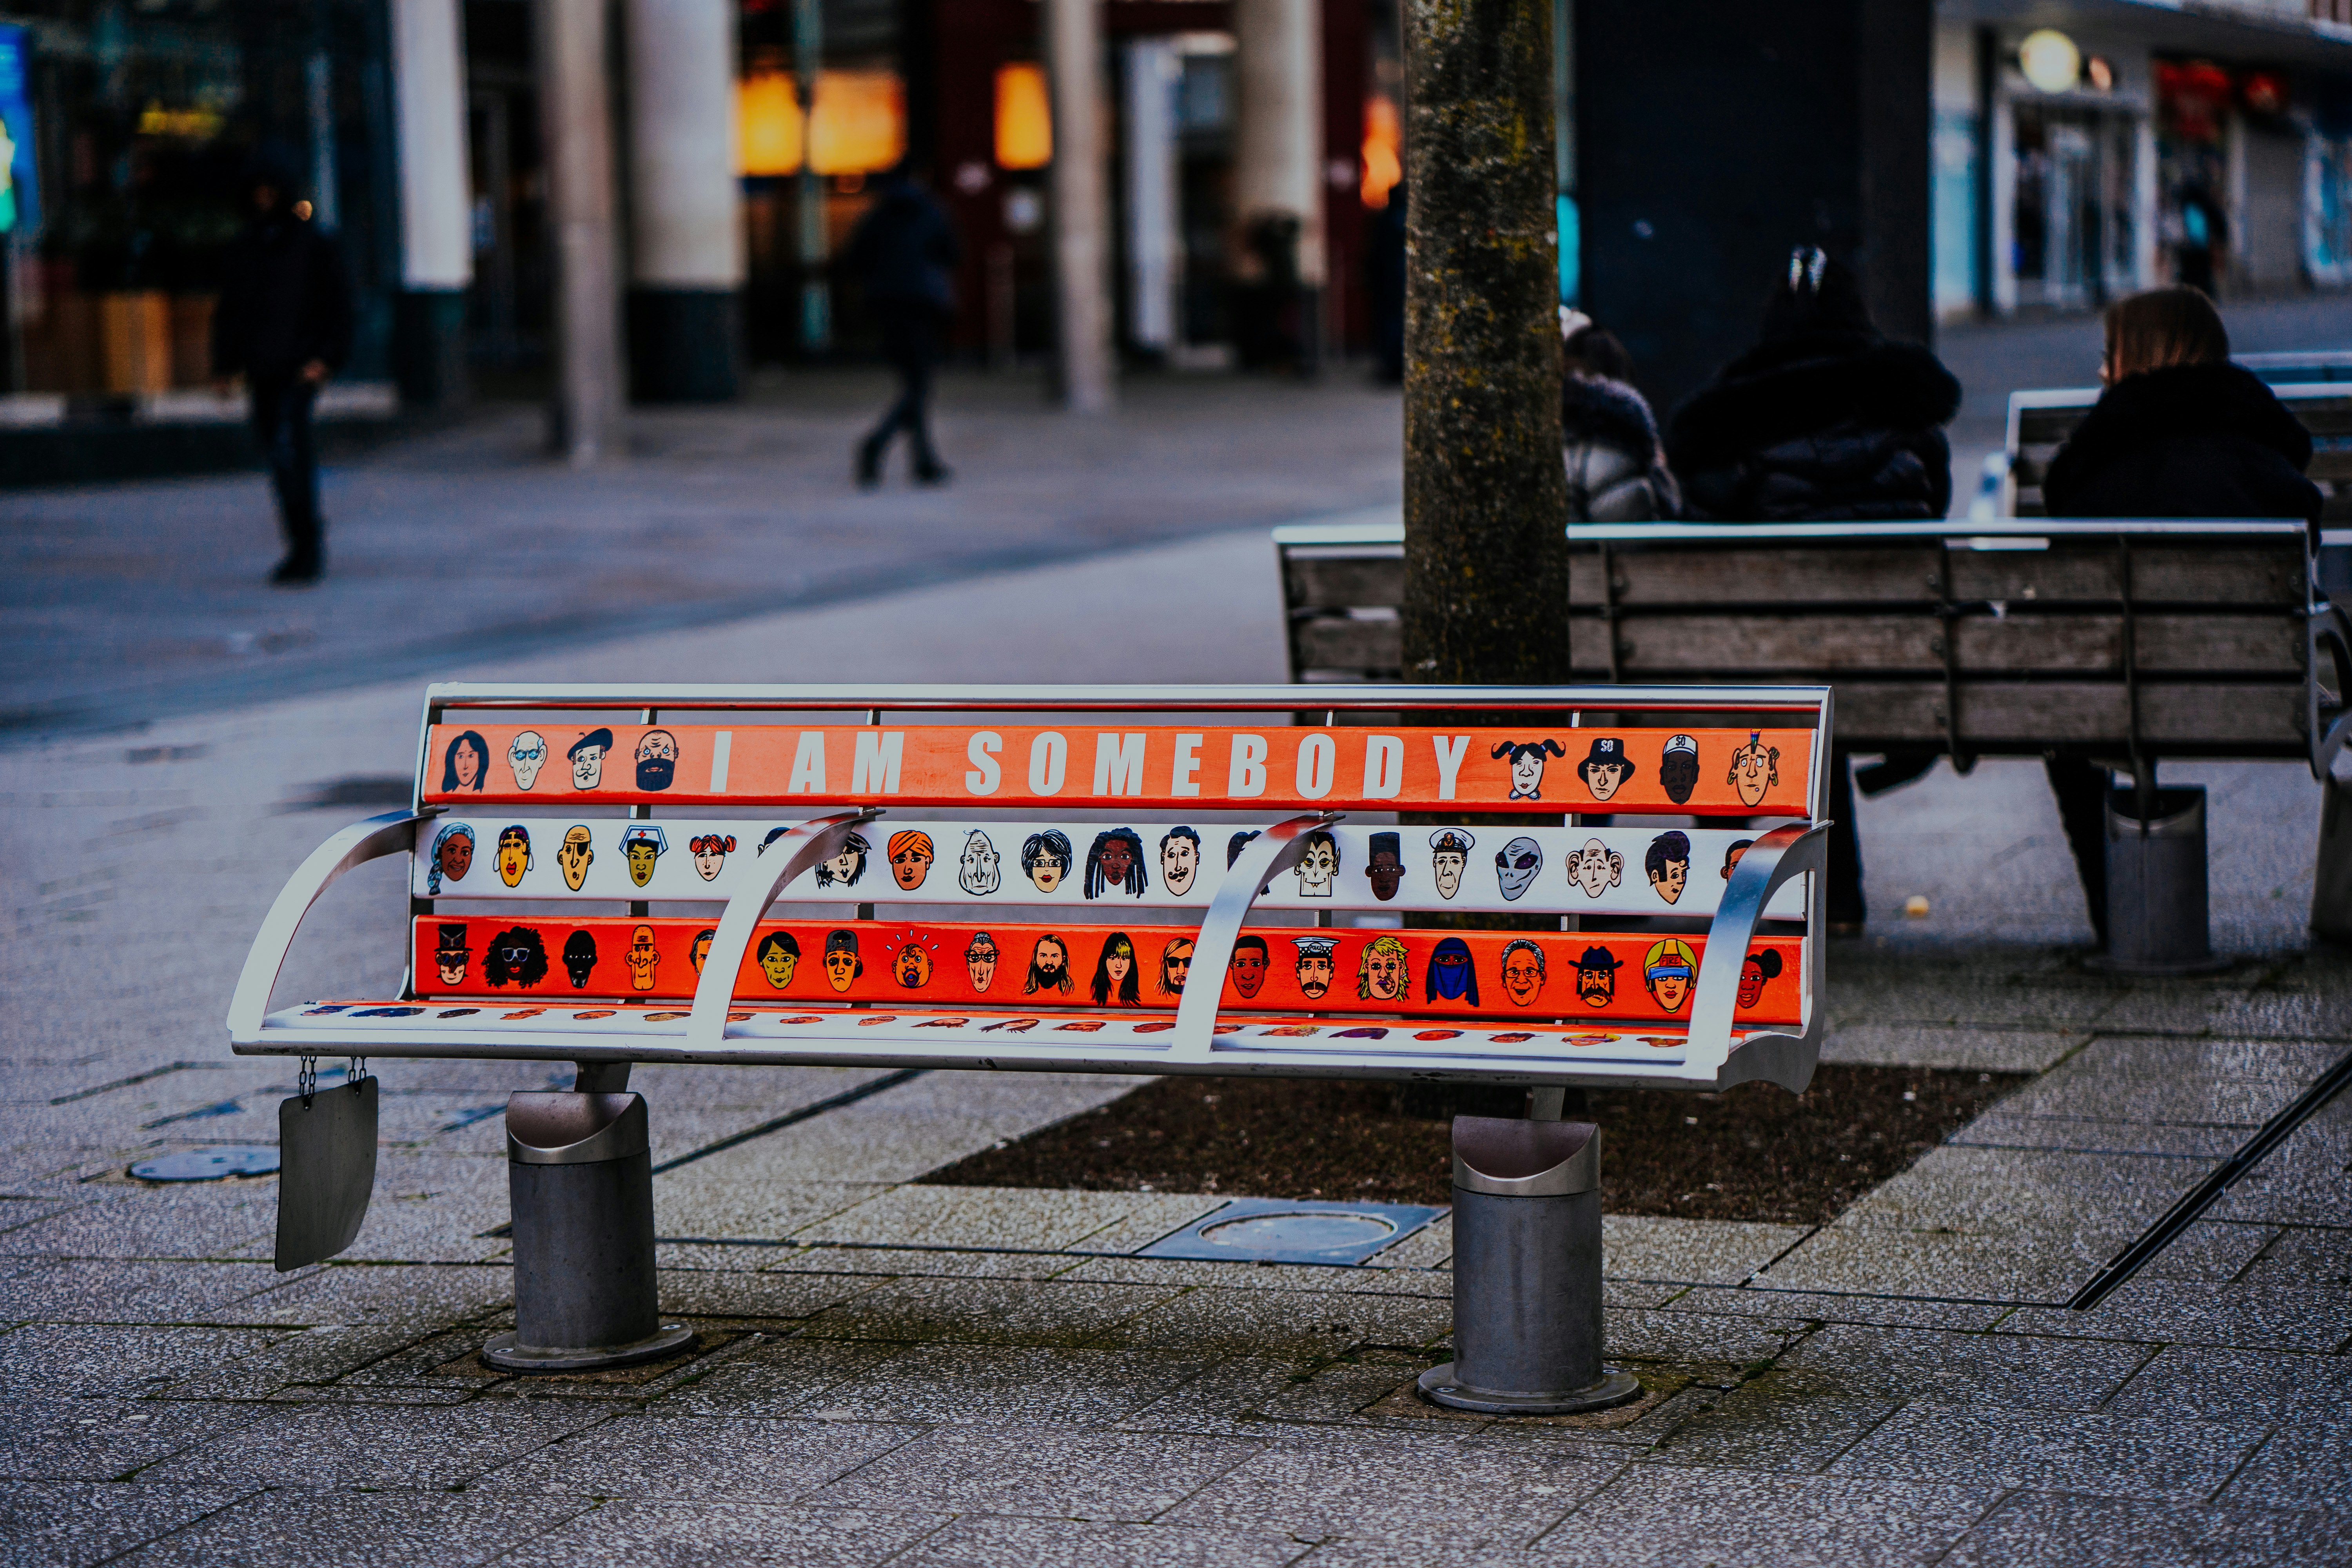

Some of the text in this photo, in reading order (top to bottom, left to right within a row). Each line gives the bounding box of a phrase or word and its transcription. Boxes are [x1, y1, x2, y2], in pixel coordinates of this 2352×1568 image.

[710, 730, 1471, 800] I AM SOMEBODY
[1662, 956, 1679, 965] FIRE
